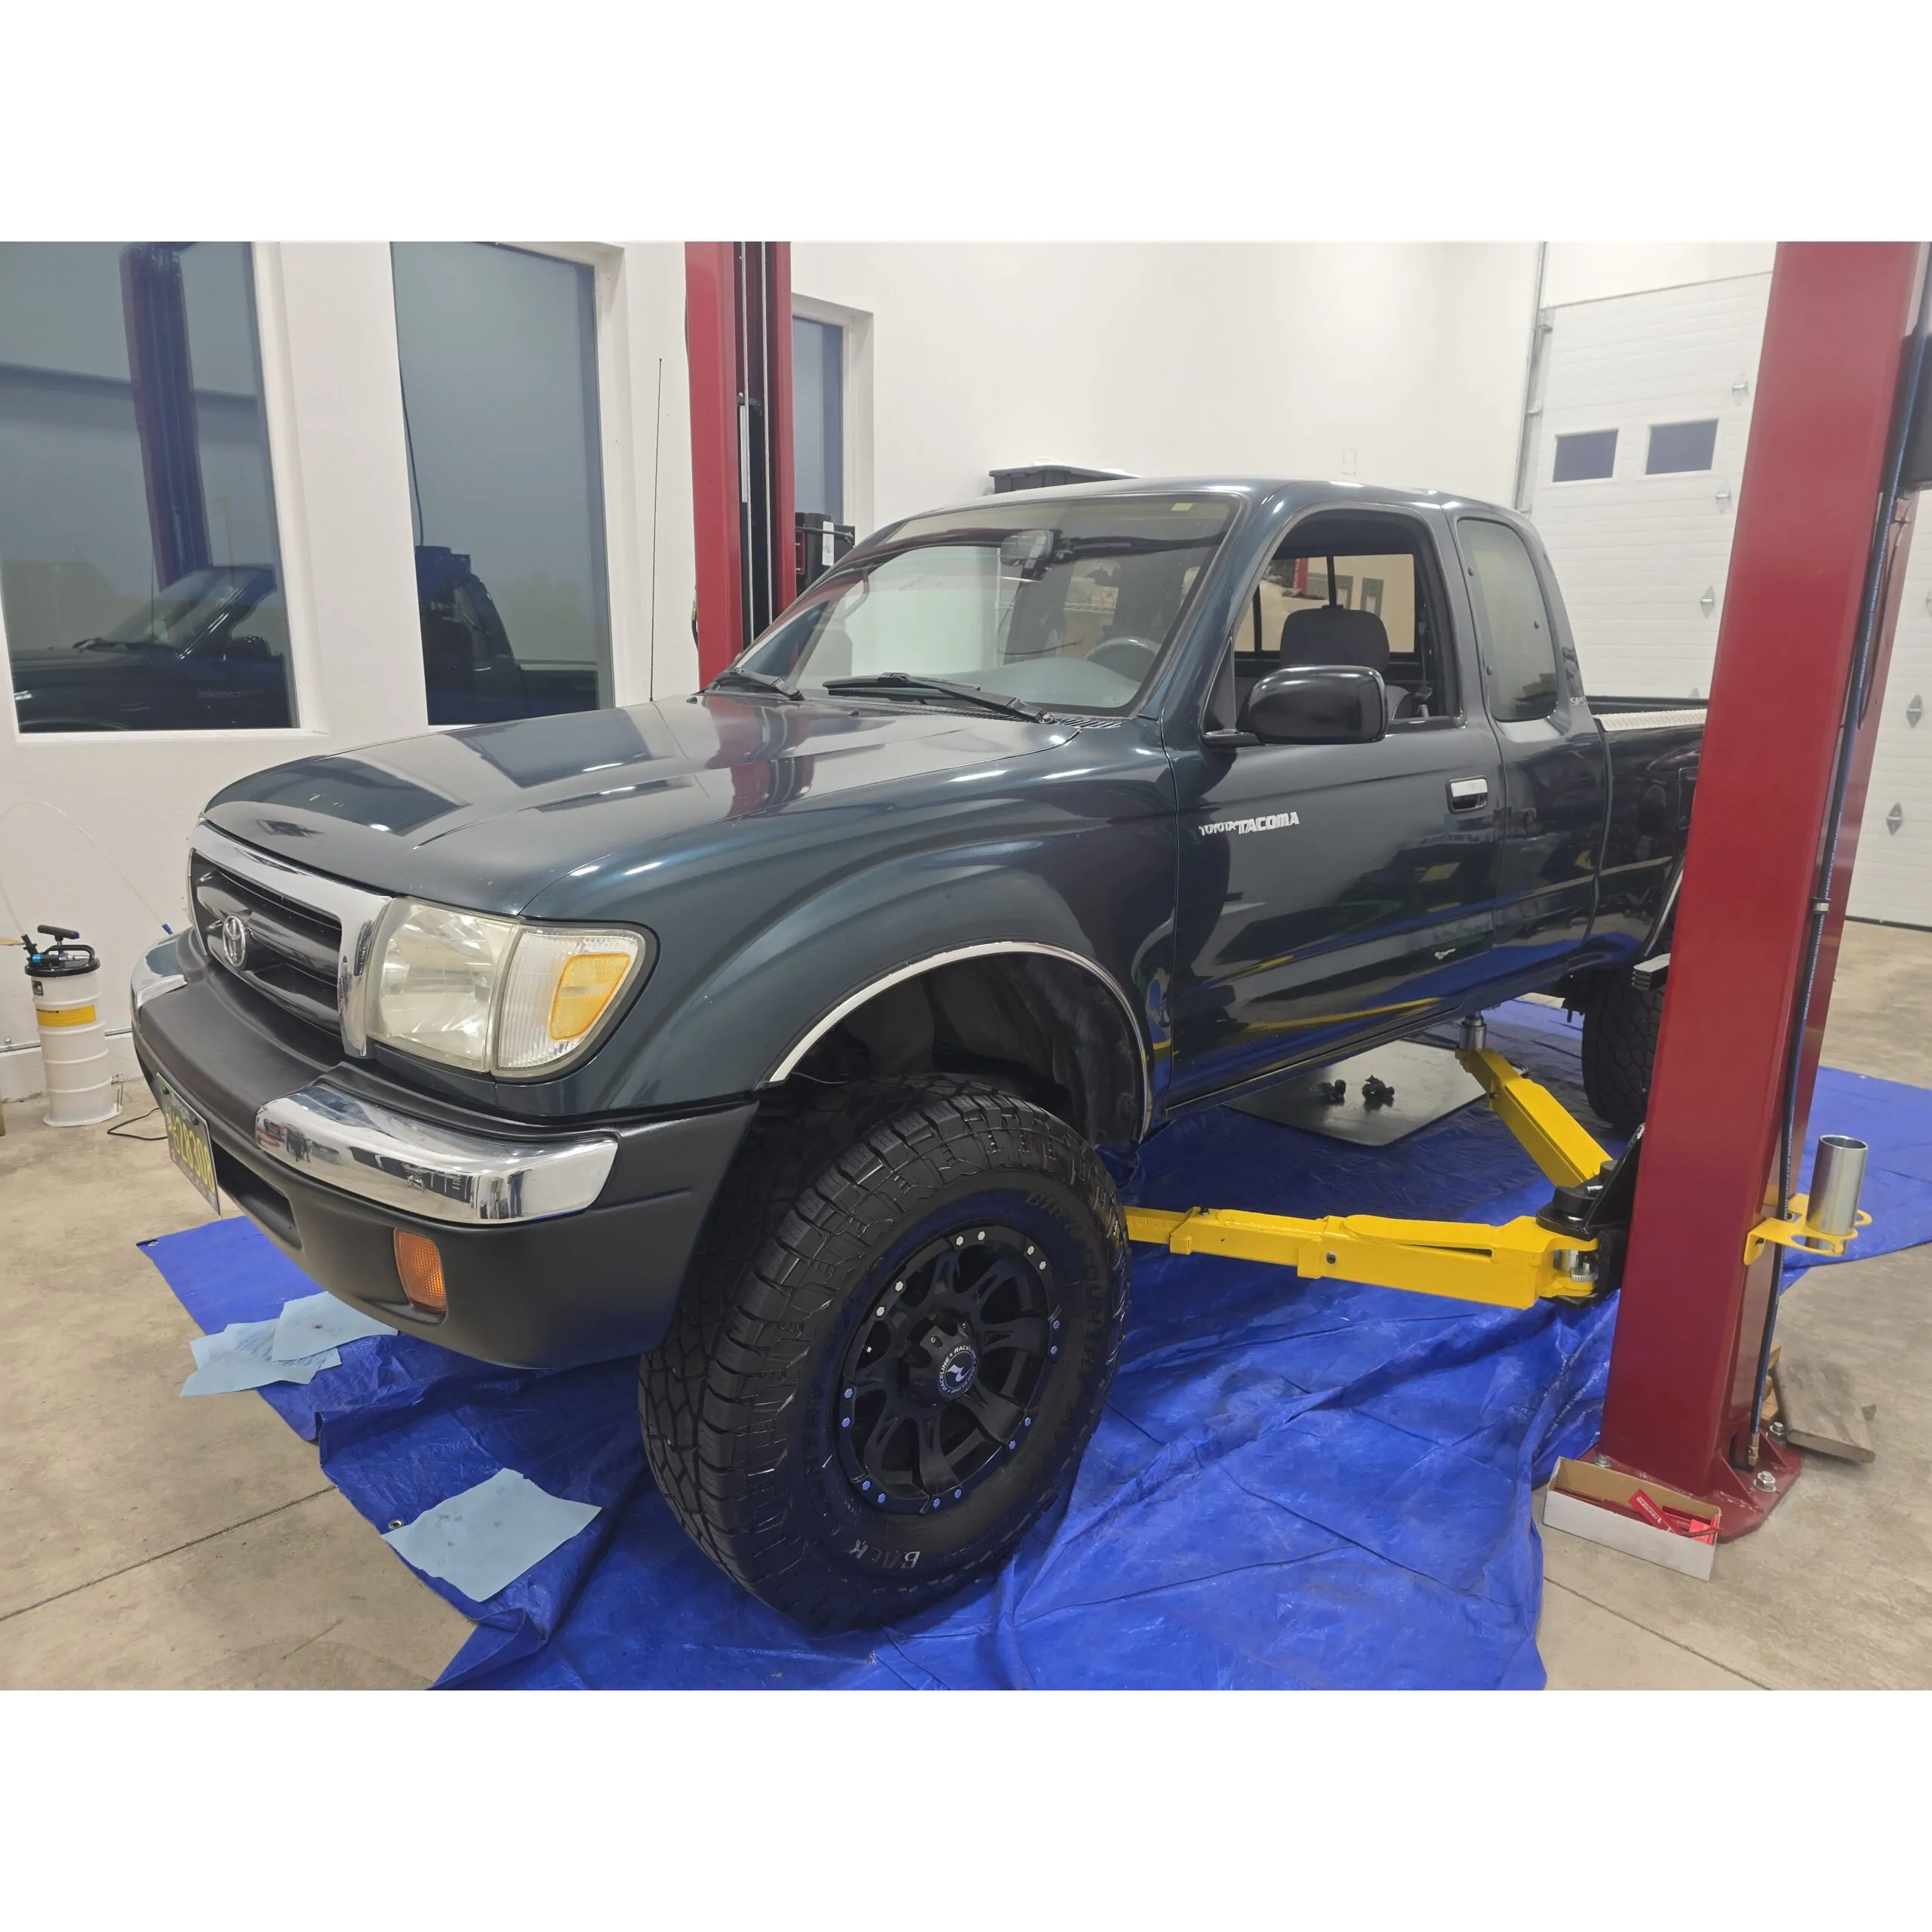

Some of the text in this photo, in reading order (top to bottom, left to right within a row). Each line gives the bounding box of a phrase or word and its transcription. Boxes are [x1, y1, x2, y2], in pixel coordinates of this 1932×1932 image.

[1198, 811, 1300, 836] TOYOTA TACOMA
[954, 1345, 977, 1360] RACELINE
[939, 1356, 950, 1391] RACELINE
[843, 1539, 921, 1569] BACK
